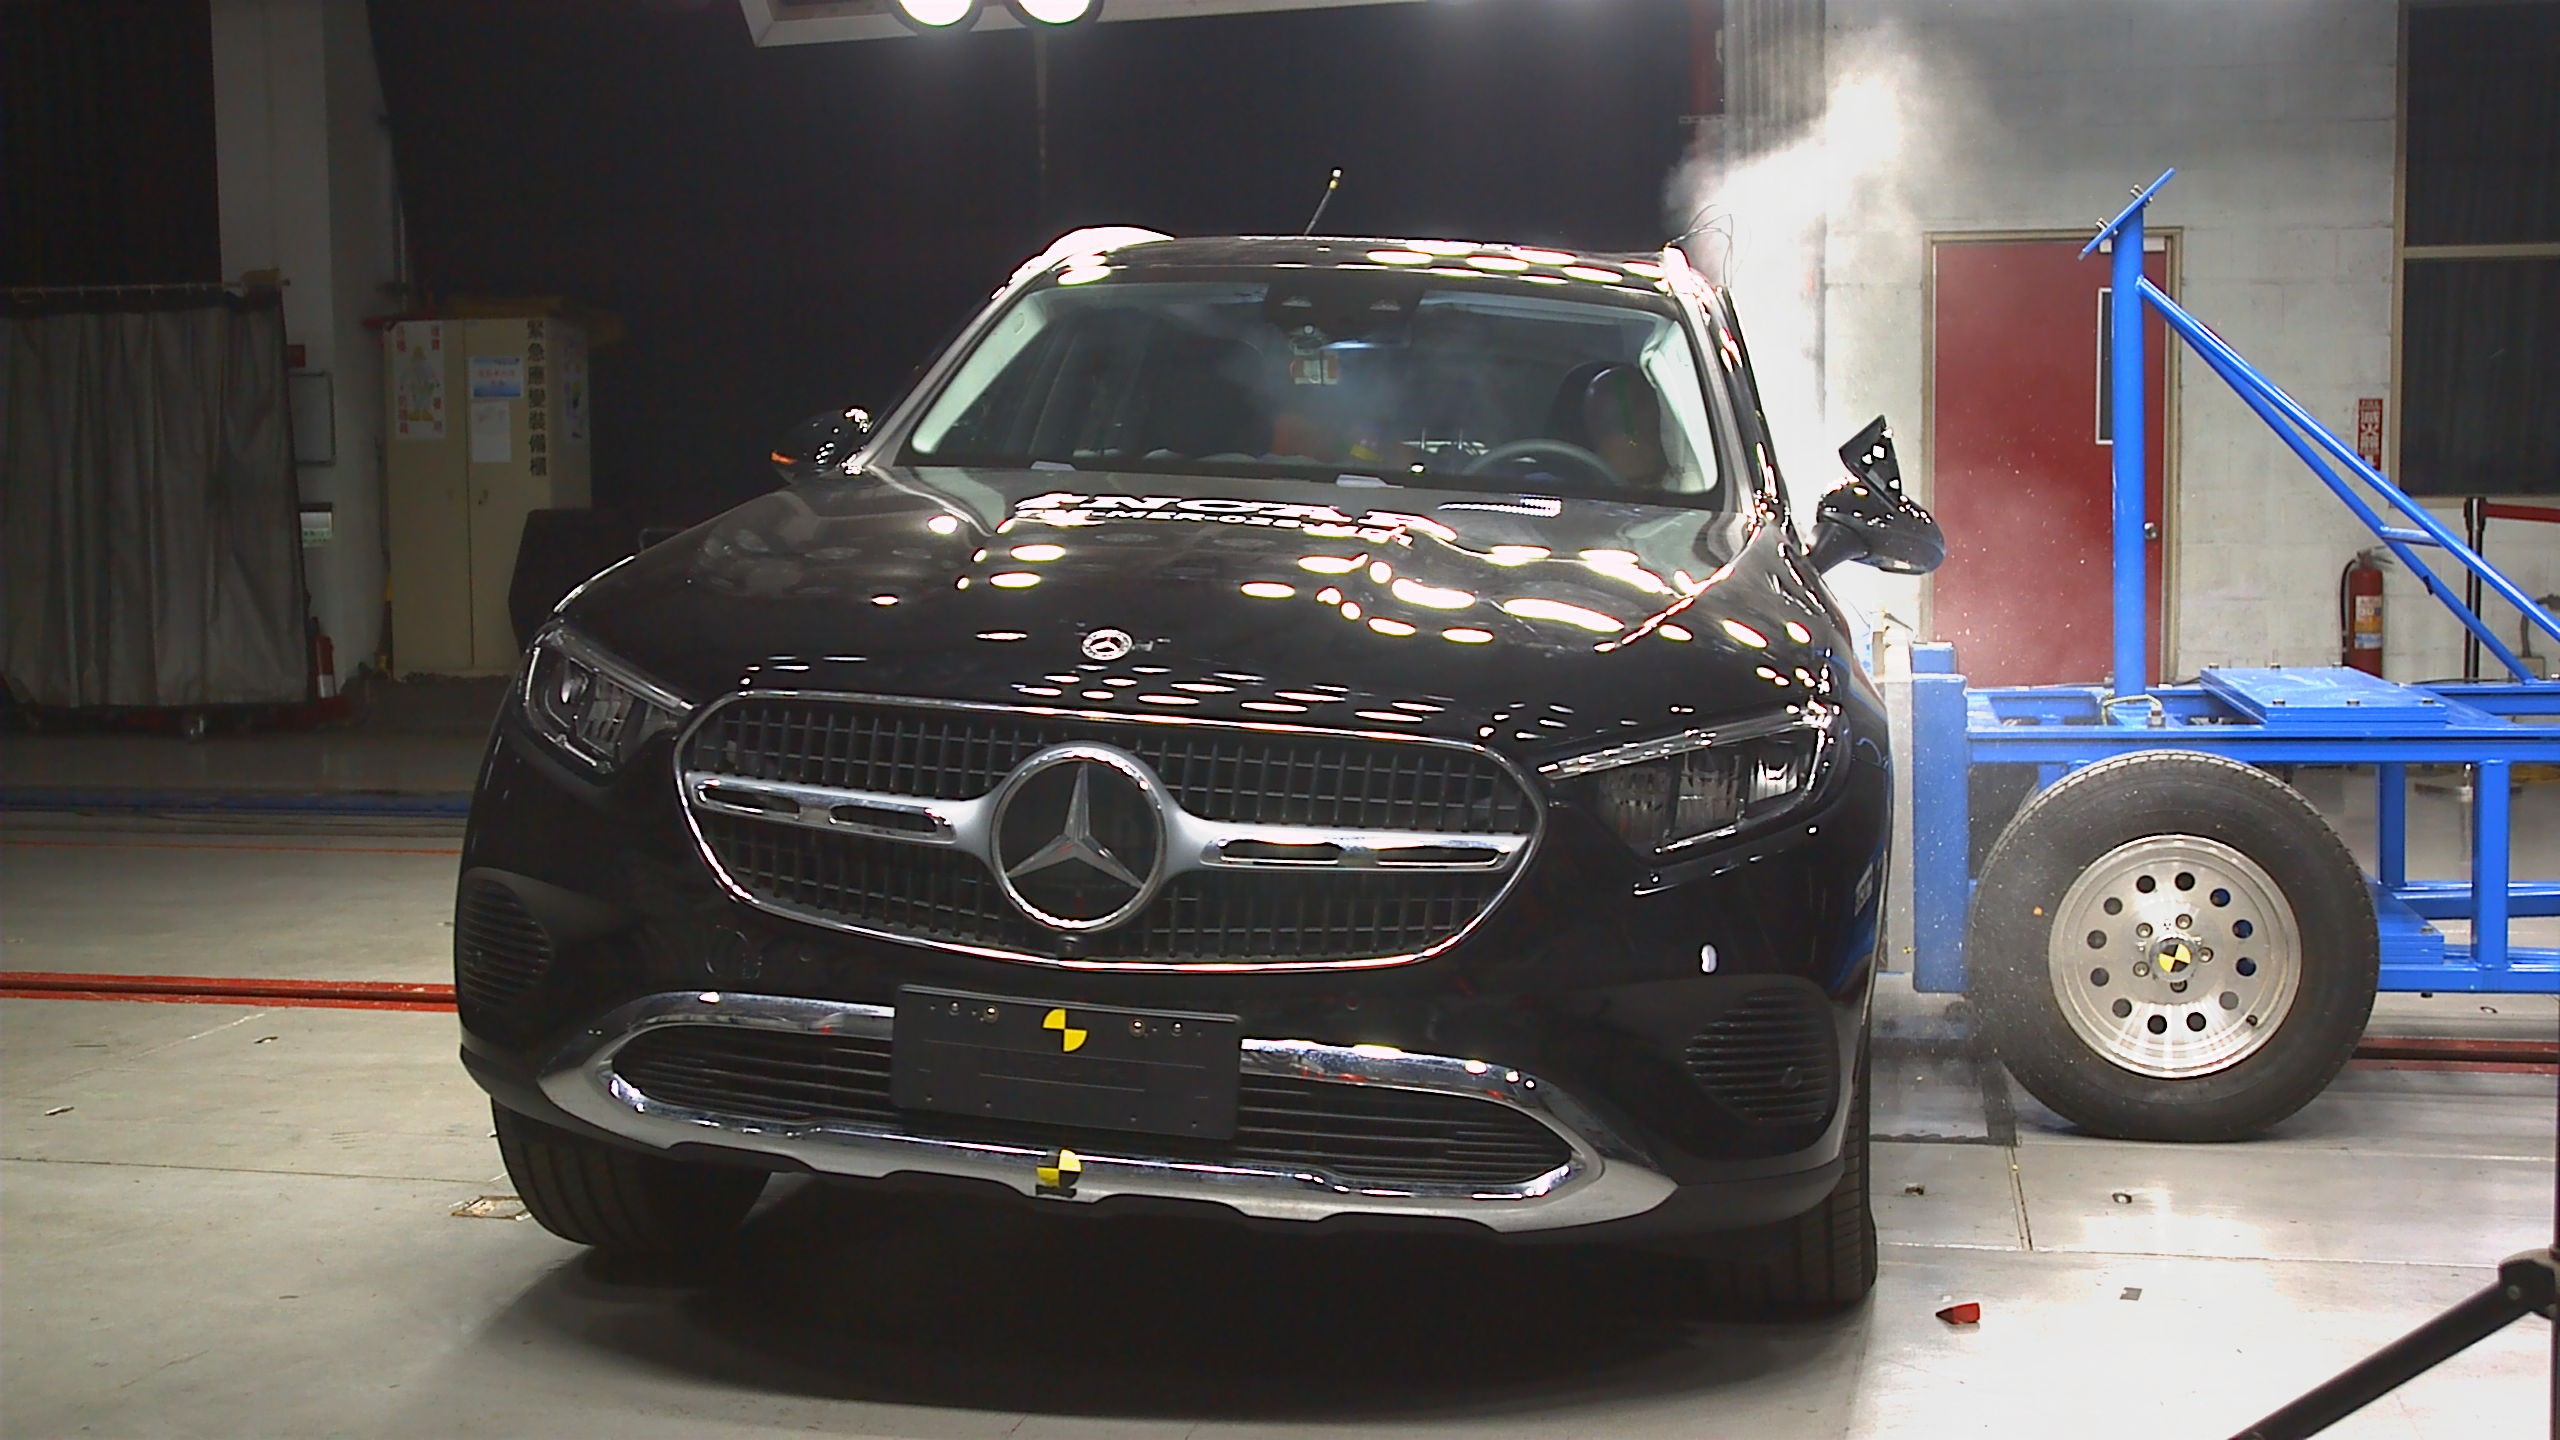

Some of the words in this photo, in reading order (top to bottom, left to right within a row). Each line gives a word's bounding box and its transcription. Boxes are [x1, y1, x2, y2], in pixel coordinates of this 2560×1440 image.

[528, 320, 547, 476] 緊急應變裝備櫃
